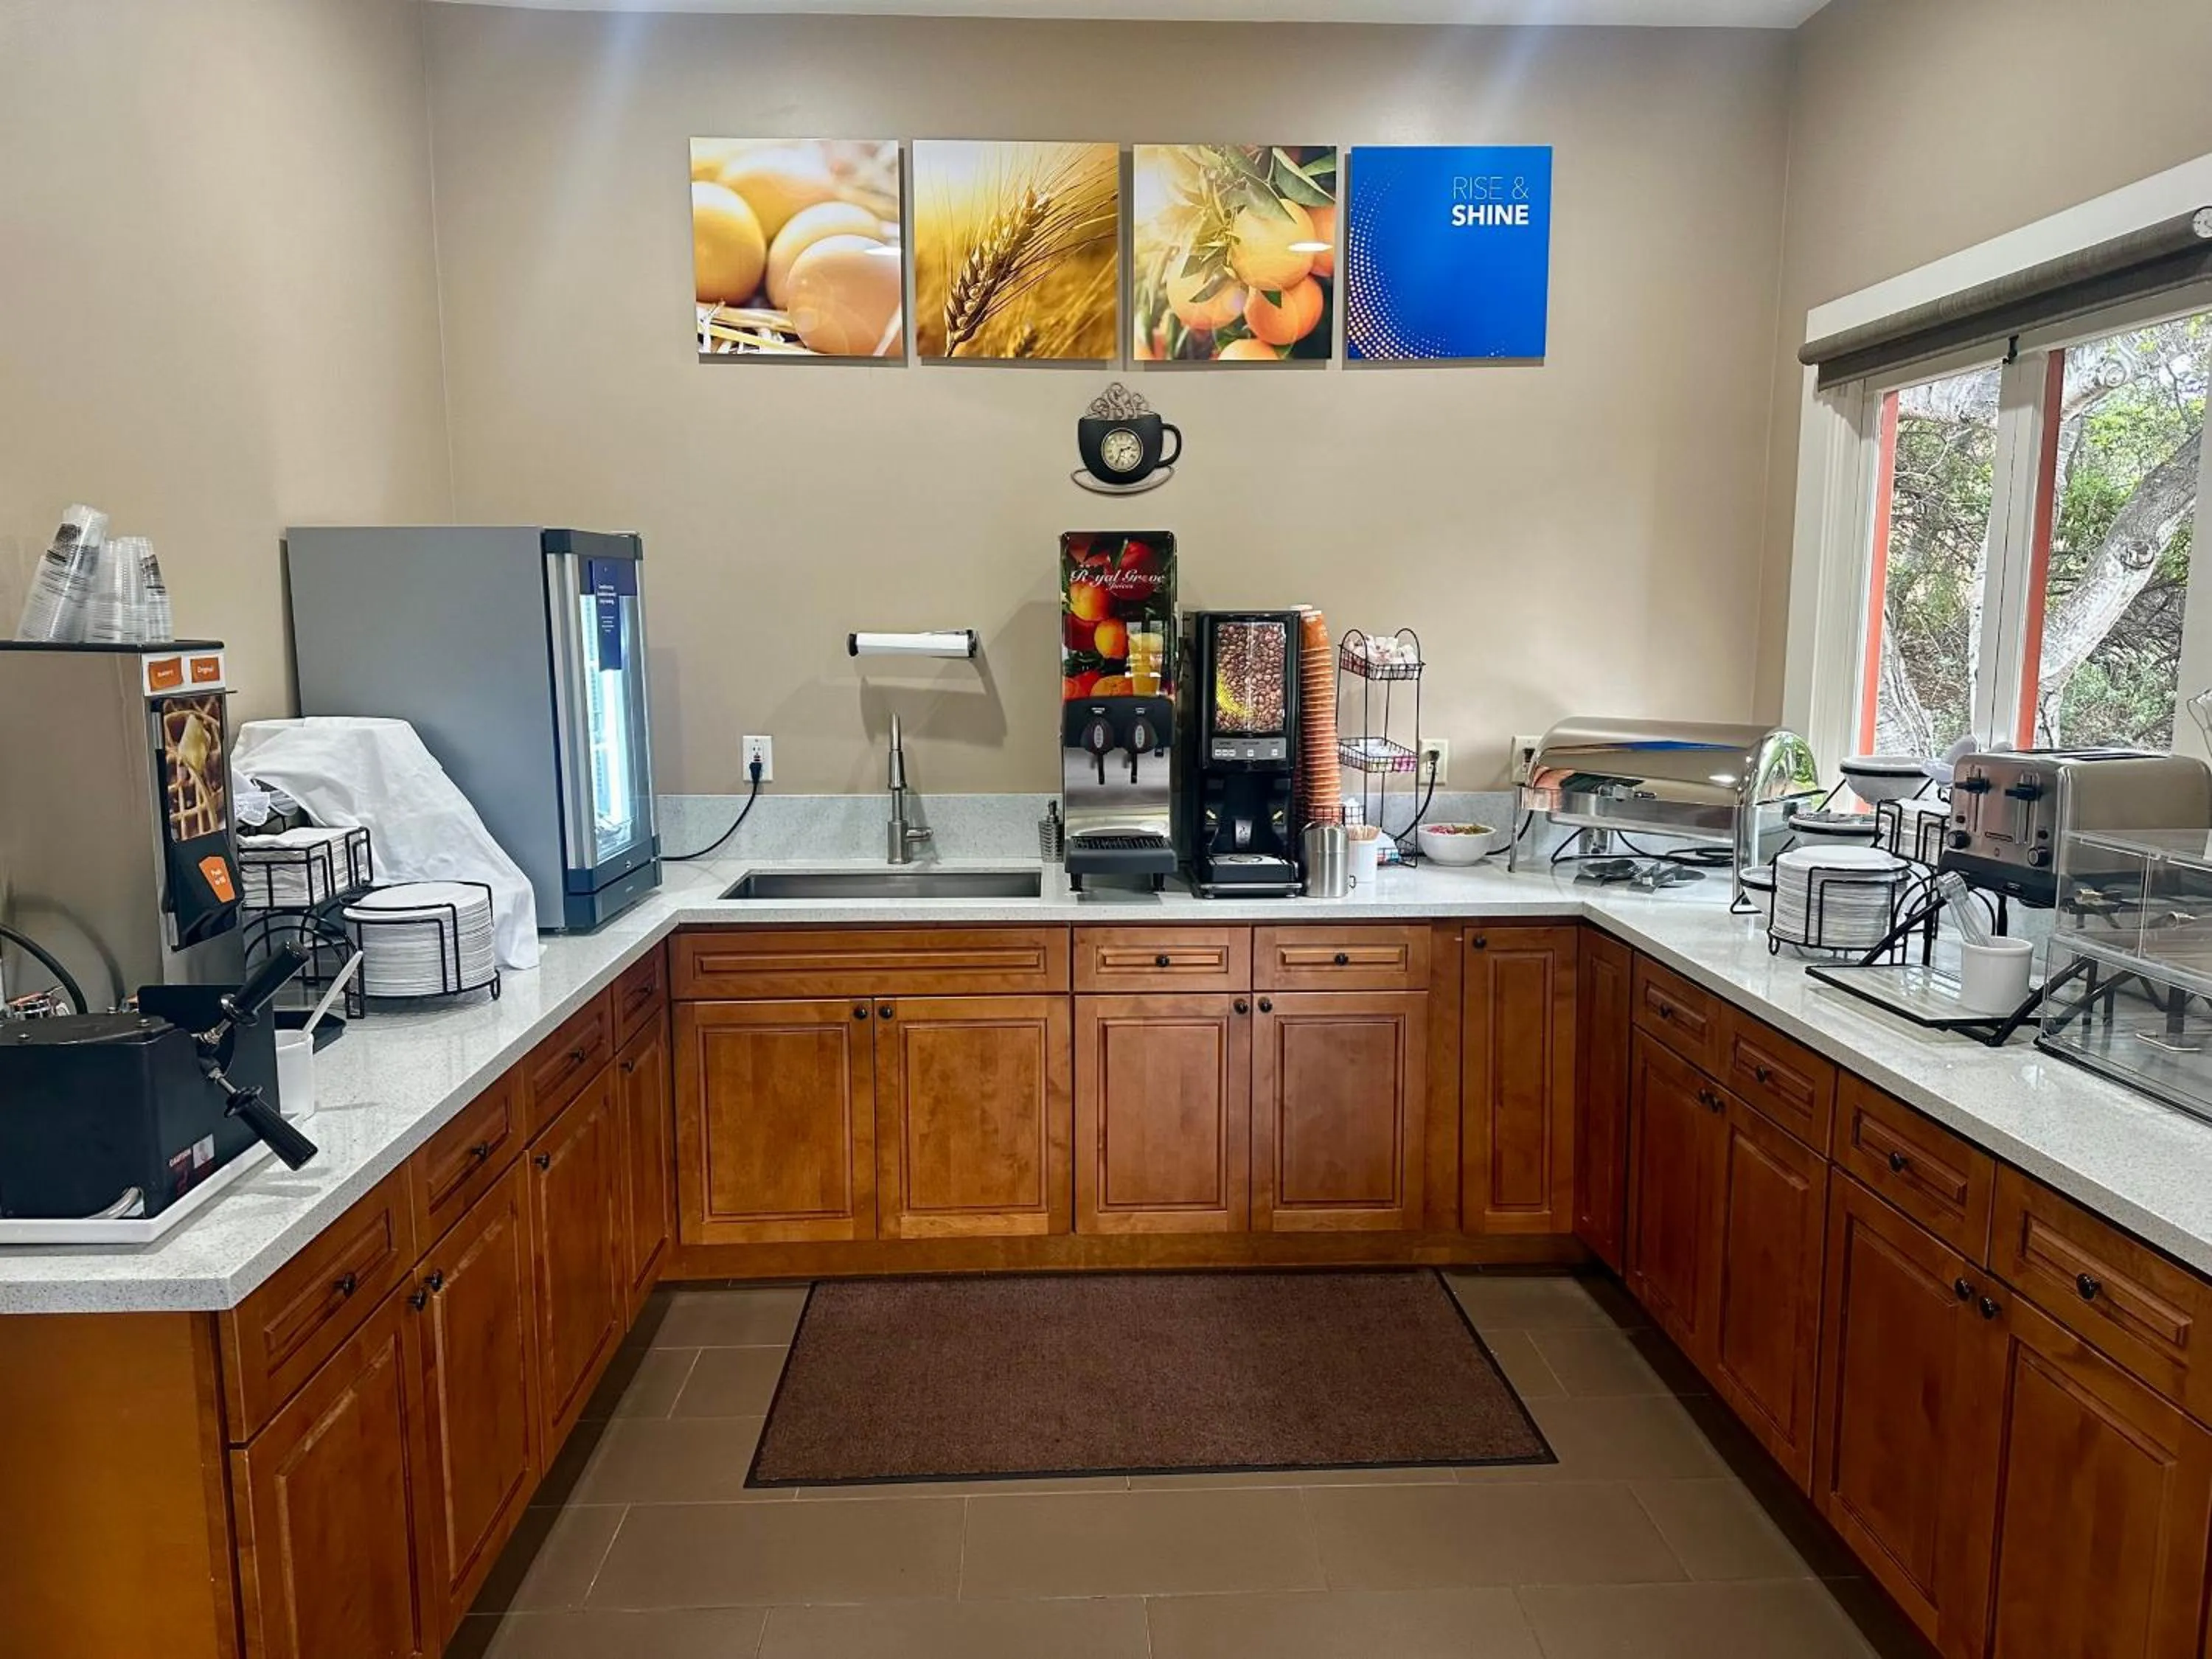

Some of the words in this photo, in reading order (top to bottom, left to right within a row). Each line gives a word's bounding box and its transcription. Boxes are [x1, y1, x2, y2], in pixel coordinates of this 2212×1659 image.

[1453, 176, 1503, 200] RISE
[1512, 176, 1529, 200] &
[1451, 204, 1529, 226] SHINE
